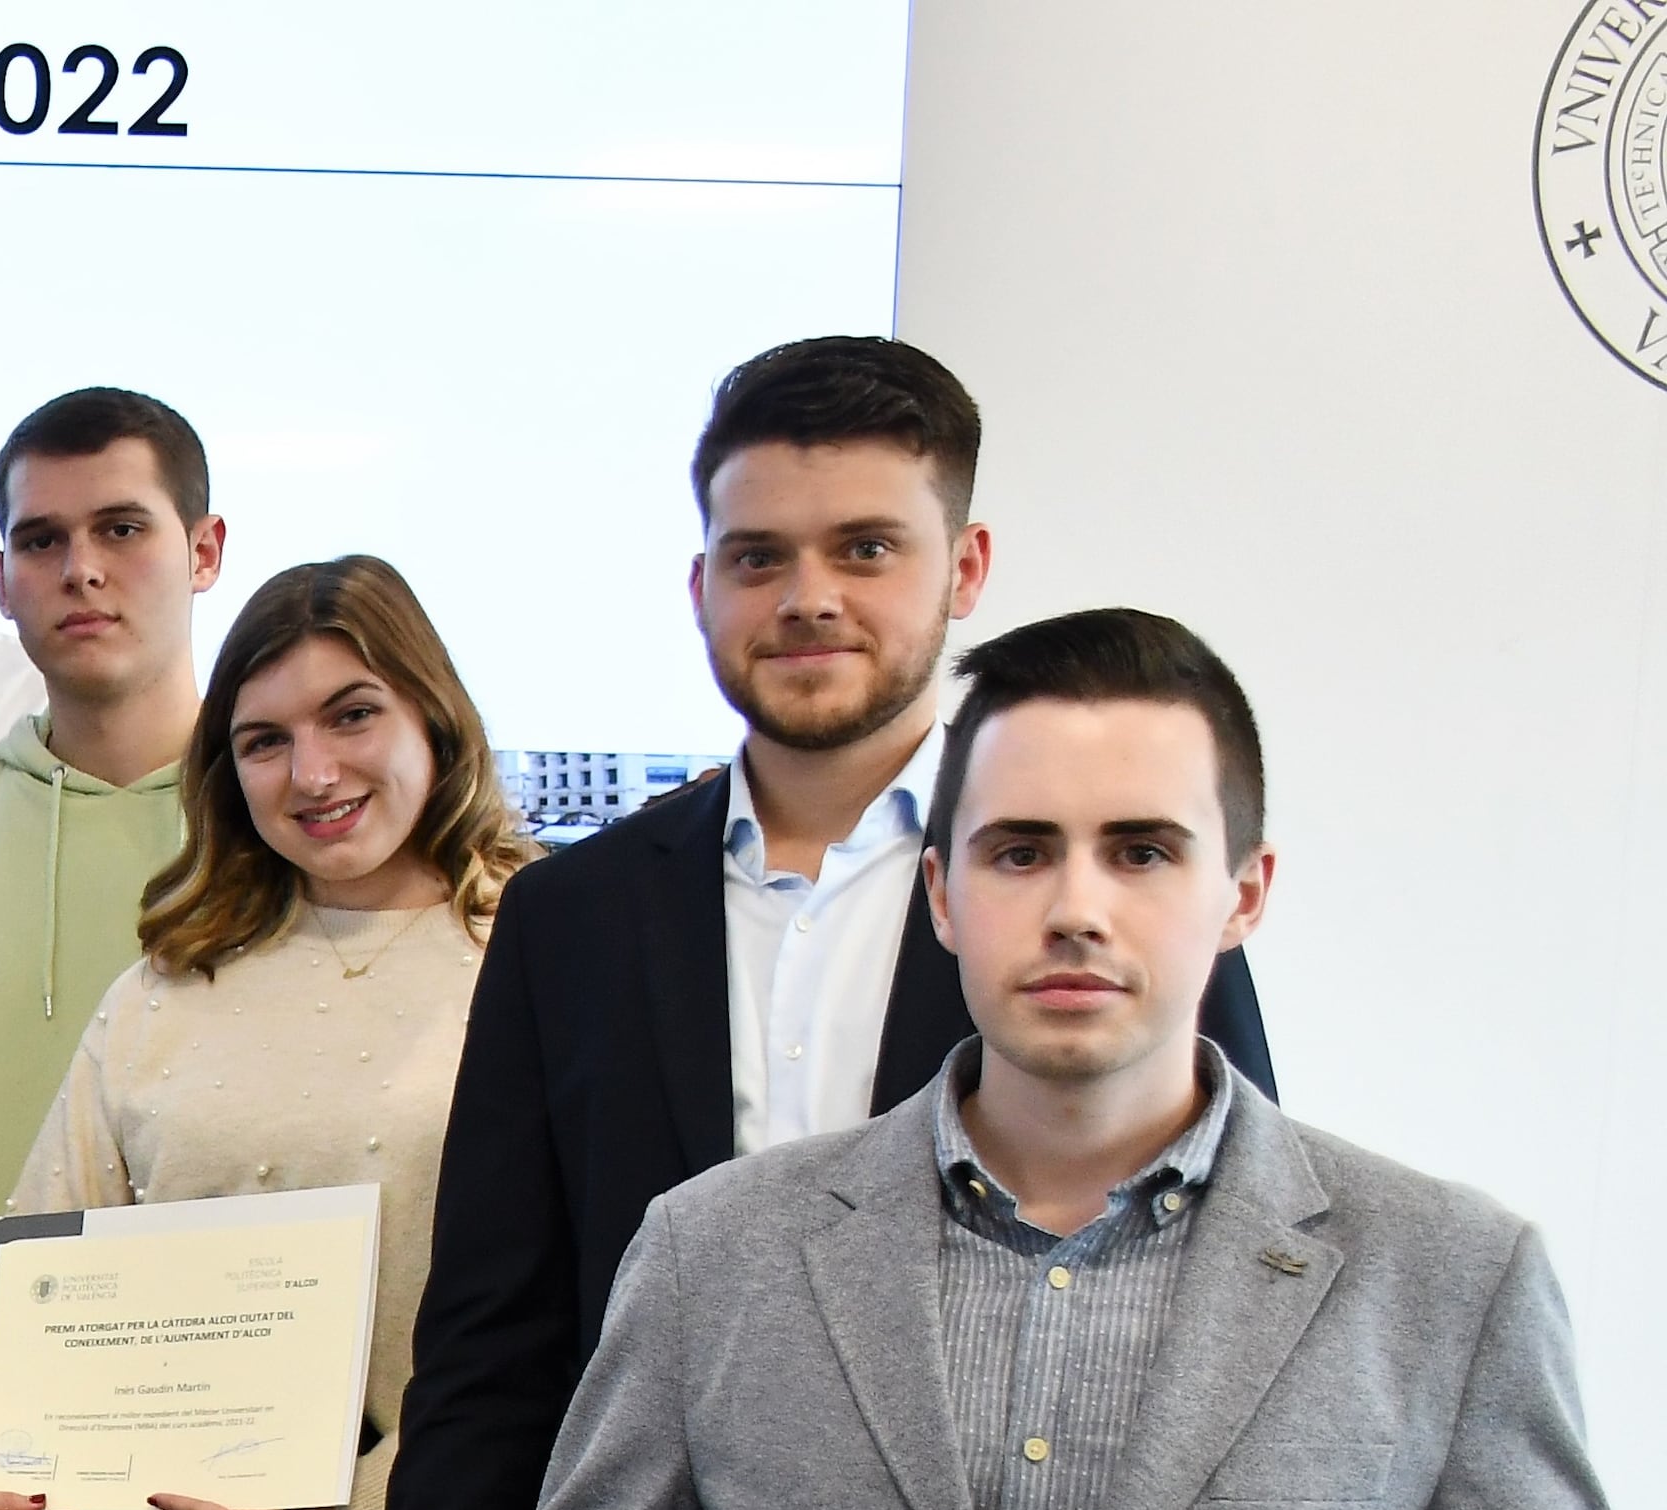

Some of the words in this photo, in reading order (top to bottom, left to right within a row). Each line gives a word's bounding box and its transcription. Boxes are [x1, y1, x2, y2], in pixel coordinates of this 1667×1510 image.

[284, 1278, 318, 1289] D'ALCOI
[43, 1324, 76, 1335] PREMI
[77, 1321, 125, 1333] ATORGAT
[126, 1320, 145, 1330] PER
[146, 1319, 159, 1329] LA
[208, 1314, 237, 1325] ALCOI
[238, 1312, 274, 1323] CIUTAT
[276, 1311, 295, 1321] DEL
[63, 1335, 138, 1350] CONEIXEMENT,
[139, 1334, 153, 1344] DE
[154, 1330, 230, 1343] L'AJUNTAMENT
[232, 1327, 271, 1339] D'ALCOI
